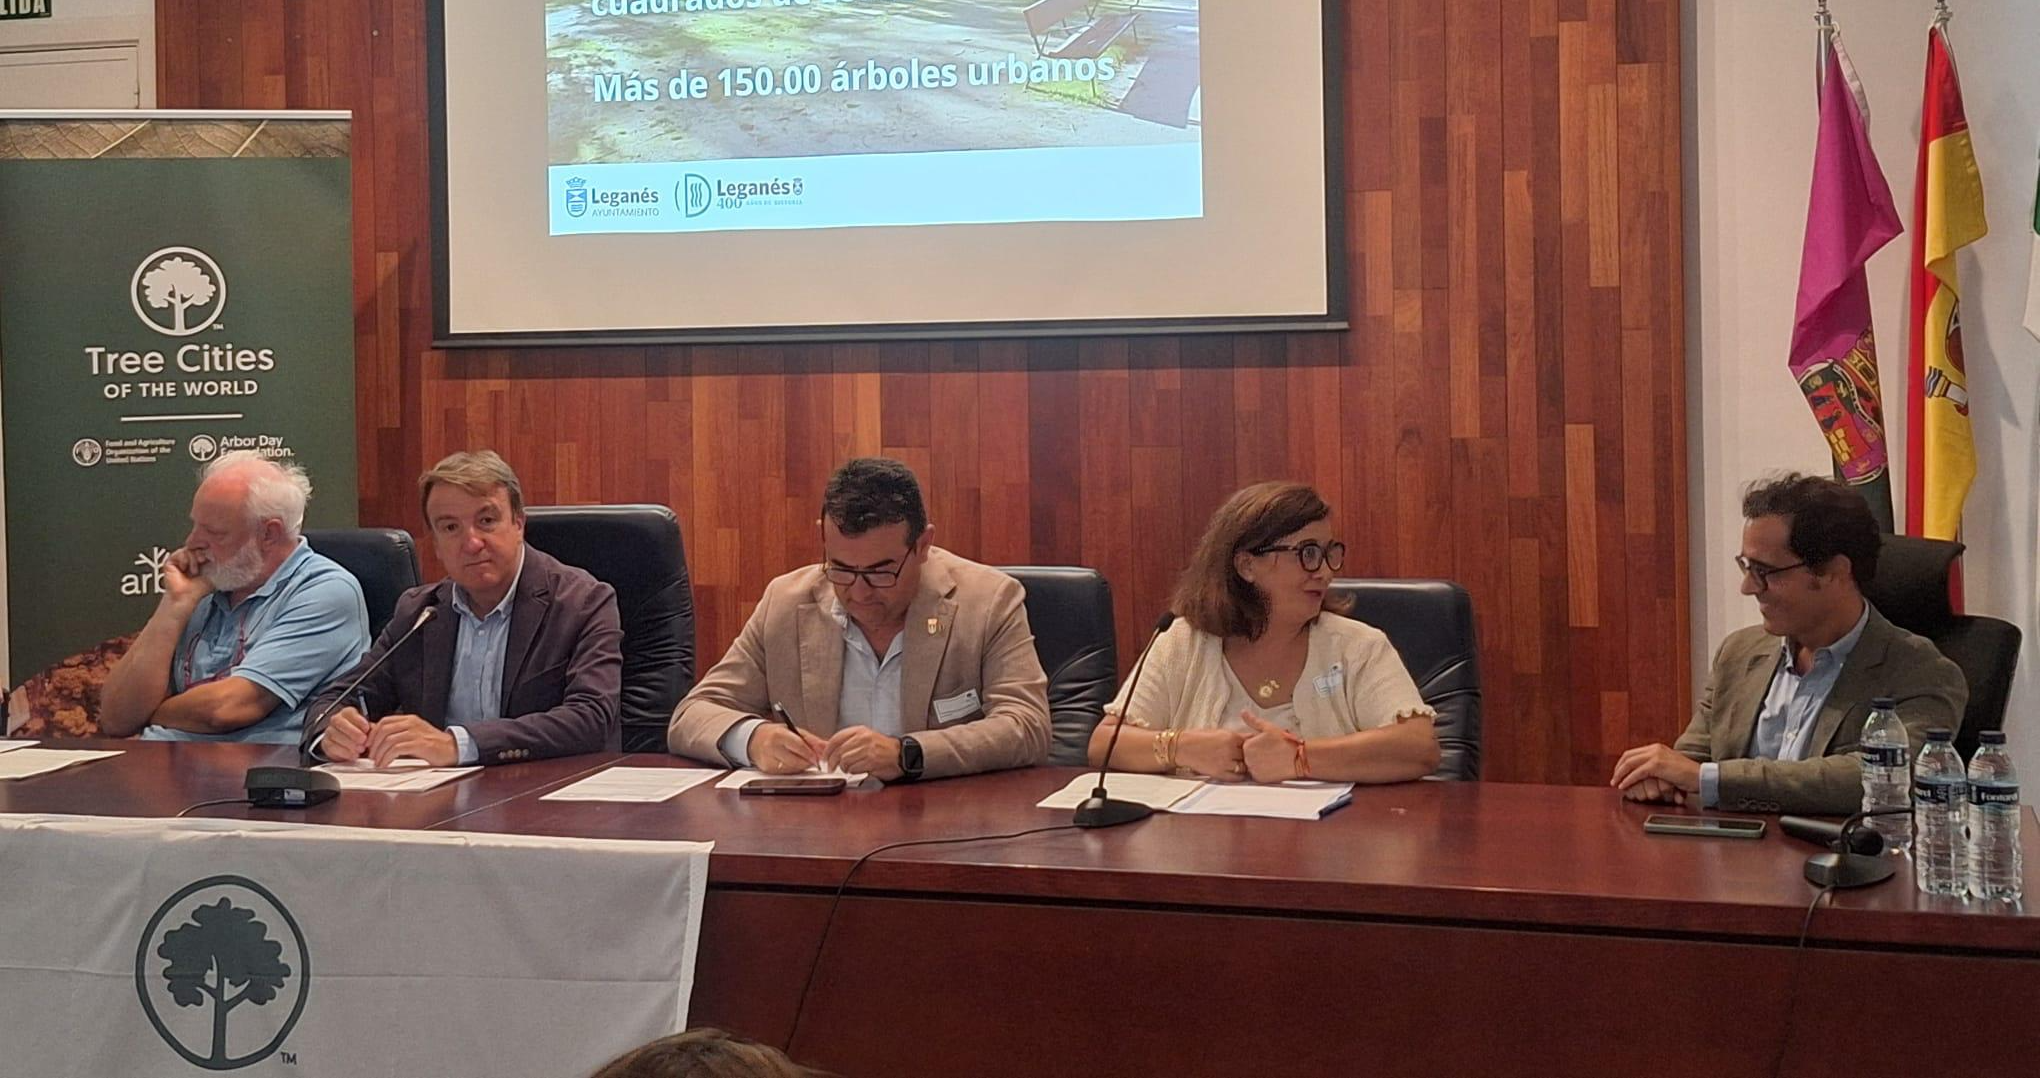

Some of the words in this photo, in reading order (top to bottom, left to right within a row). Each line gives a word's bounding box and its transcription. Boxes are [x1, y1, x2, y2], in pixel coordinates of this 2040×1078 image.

[593, 70, 659, 103] Más
[668, 69, 709, 100] de
[717, 64, 822, 98] 150.00
[830, 58, 958, 93] árboles
[967, 53, 1115, 86] urbanos
[591, 187, 659, 207] Leganés
[717, 177, 790, 199] Leganés
[591, 207, 660, 217] AYUNTAMIENTO
[717, 197, 742, 209] 400
[84, 346, 165, 375] Tree
[176, 343, 275, 373] Cities
[103, 383, 132, 399] OF
[138, 382, 177, 398] THE
[184, 380, 258, 396] WORLD
[220, 436, 257, 447] Arbor
[259, 435, 284, 448] Day
[280, 1052, 297, 1065] TM
